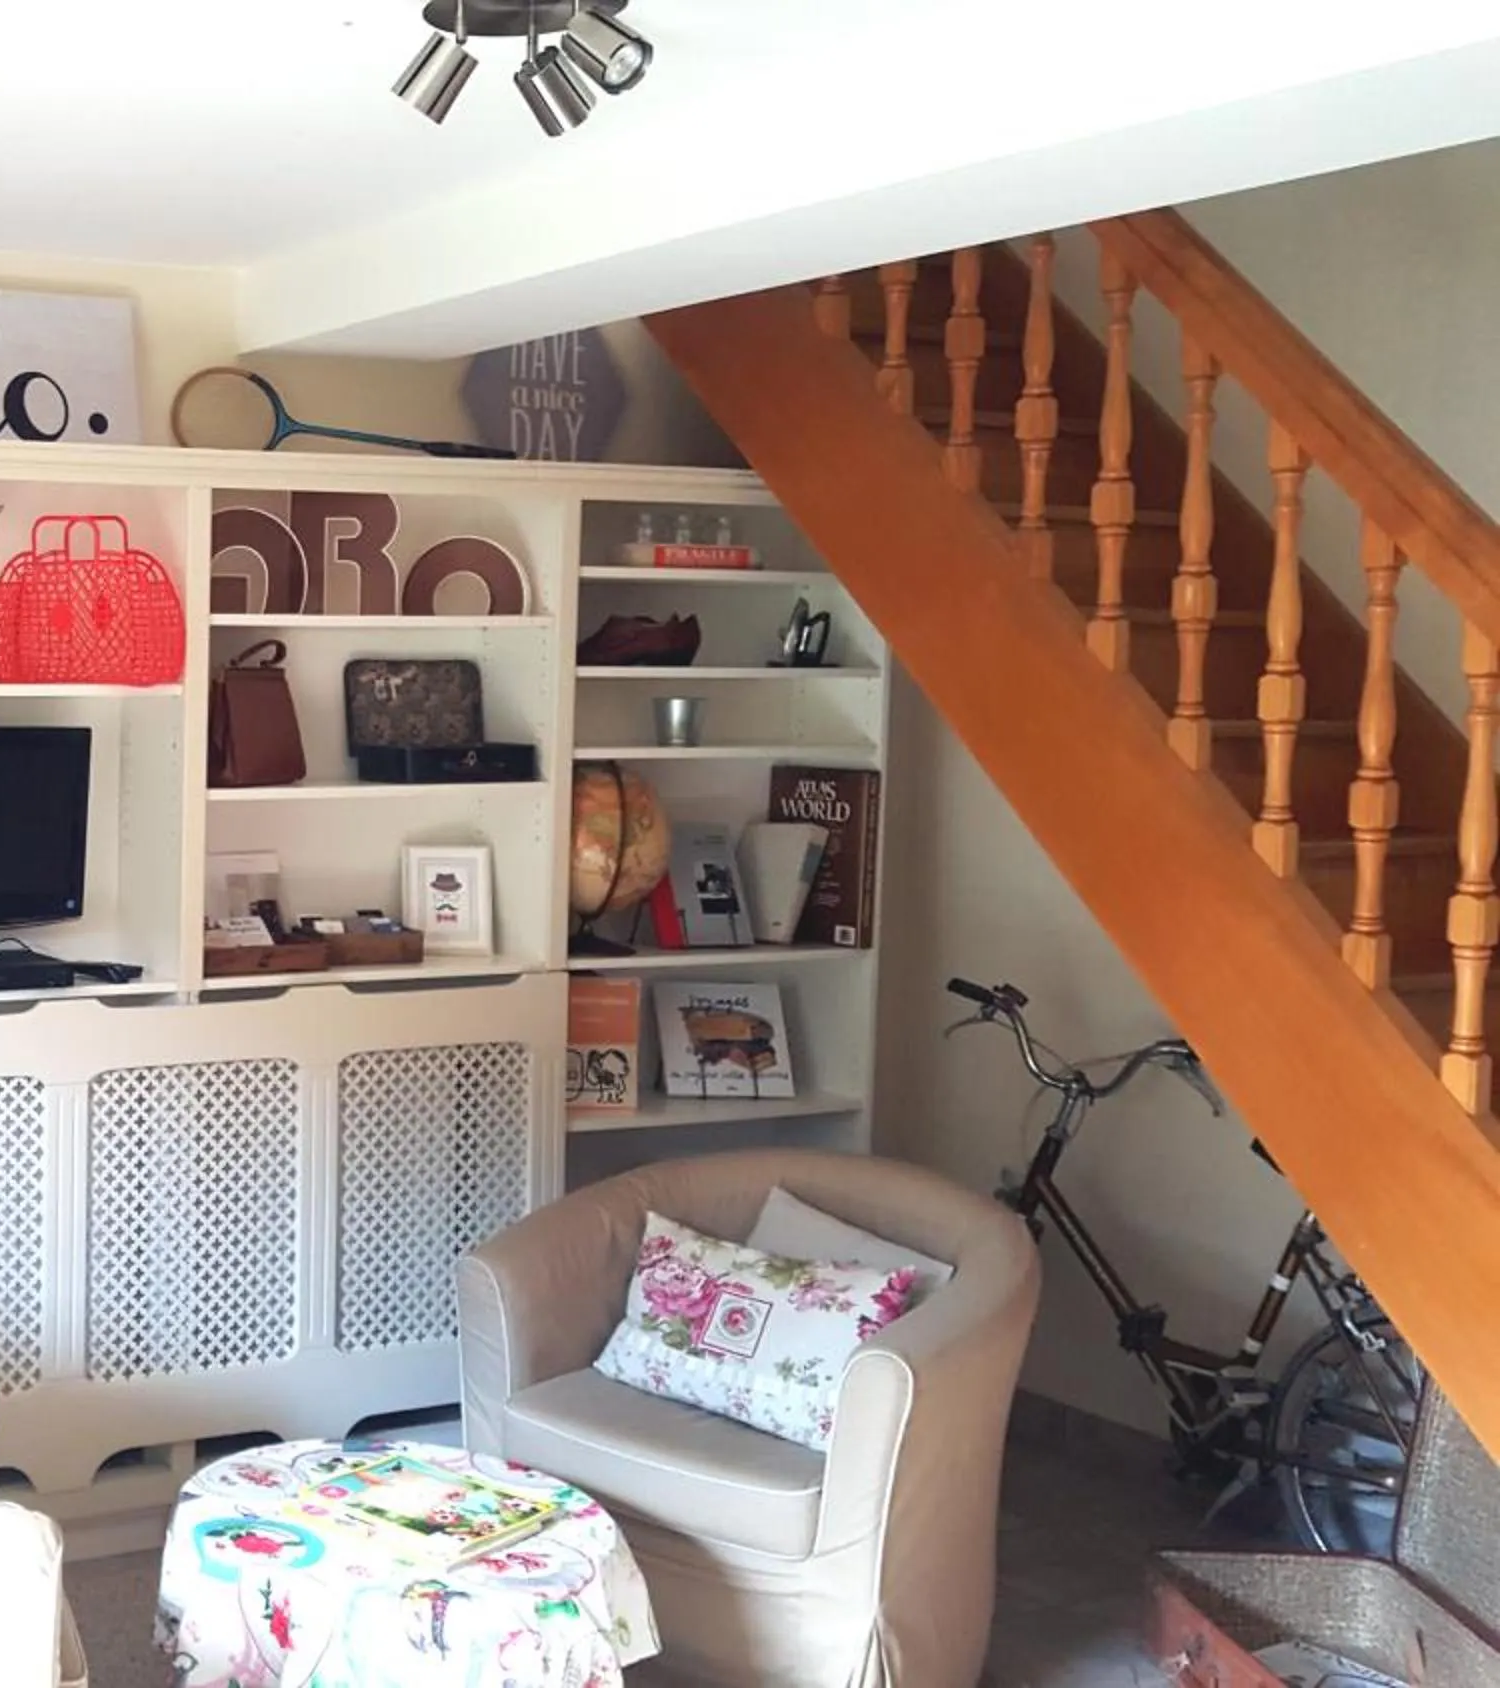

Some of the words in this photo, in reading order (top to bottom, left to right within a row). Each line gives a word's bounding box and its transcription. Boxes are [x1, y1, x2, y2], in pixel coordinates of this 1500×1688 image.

[510, 330, 587, 385] HAVE
[533, 383, 586, 415] nice
[510, 408, 584, 462] DAY
[781, 797, 851, 823] WORLD
